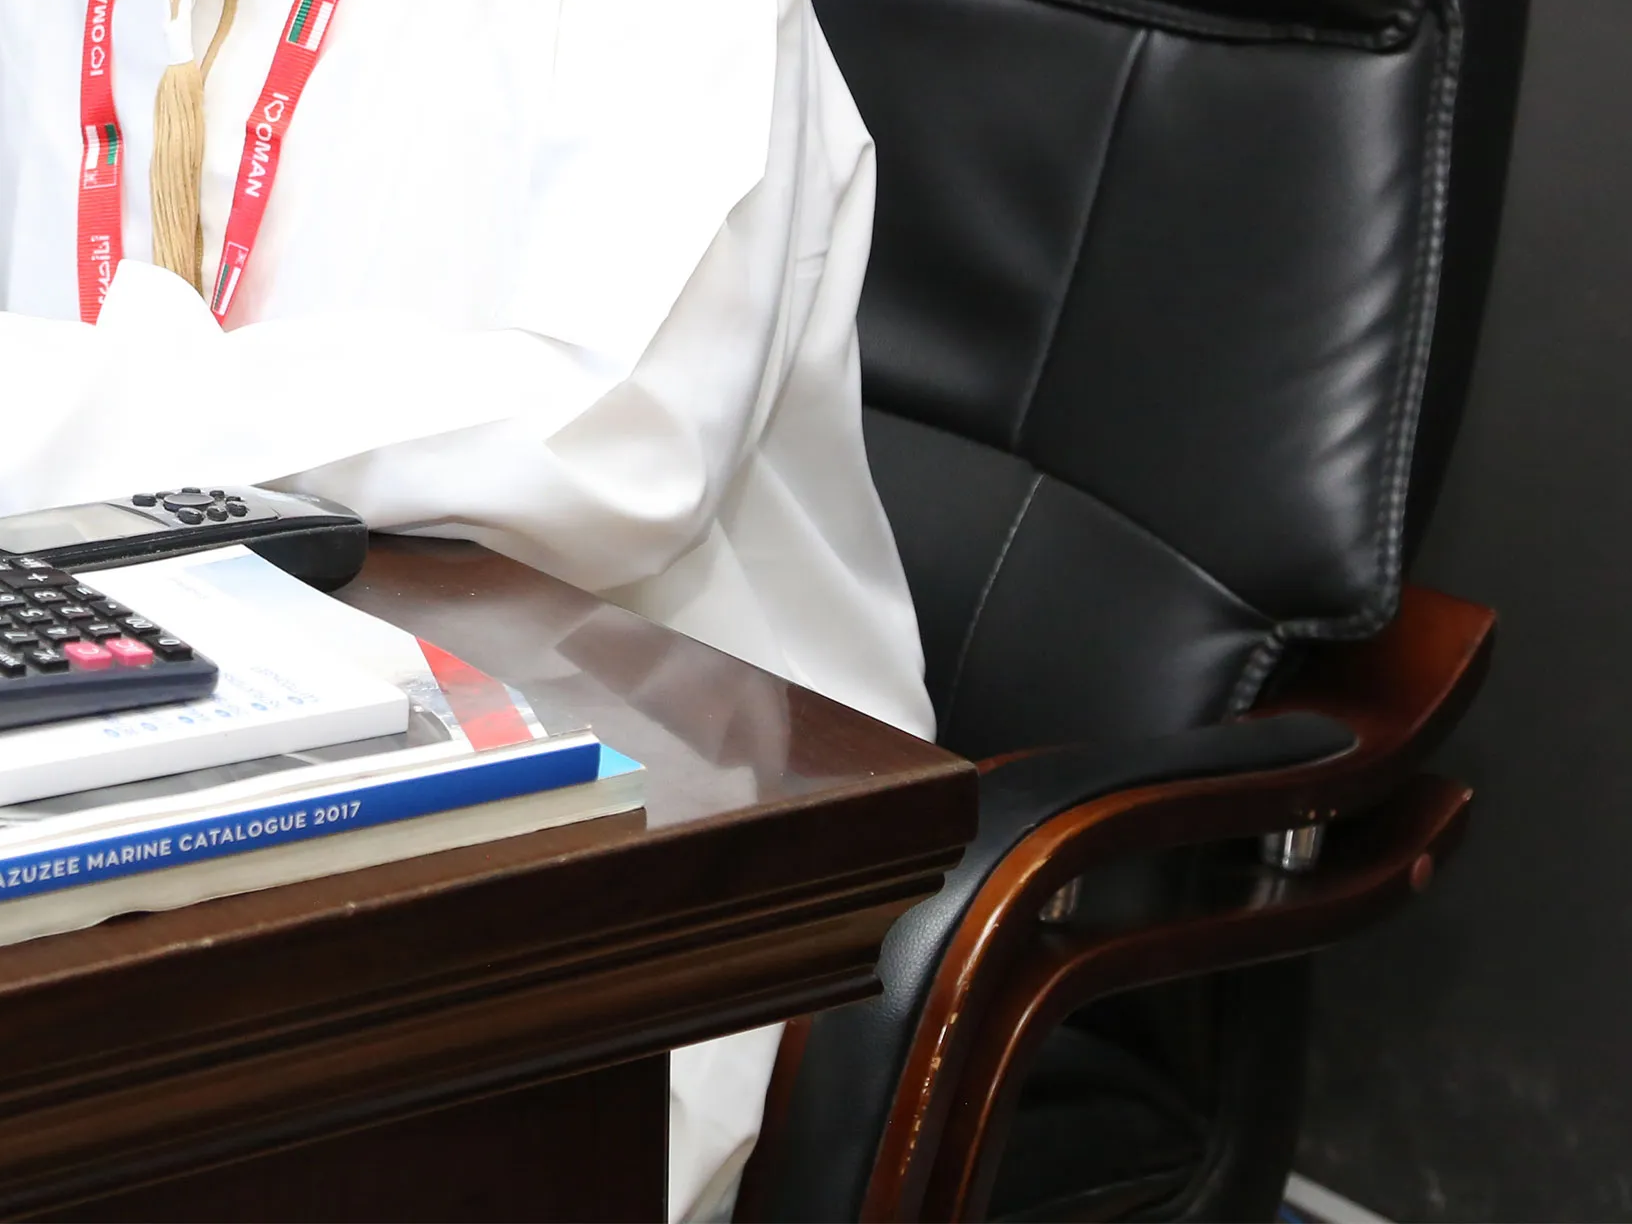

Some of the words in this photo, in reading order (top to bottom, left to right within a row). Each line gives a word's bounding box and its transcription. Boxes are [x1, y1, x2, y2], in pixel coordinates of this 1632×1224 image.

[245, 122, 273, 198] OMAN
[87, 839, 173, 872] MARINE
[178, 811, 307, 852] CATALOGUE
[313, 800, 361, 828] 2017
